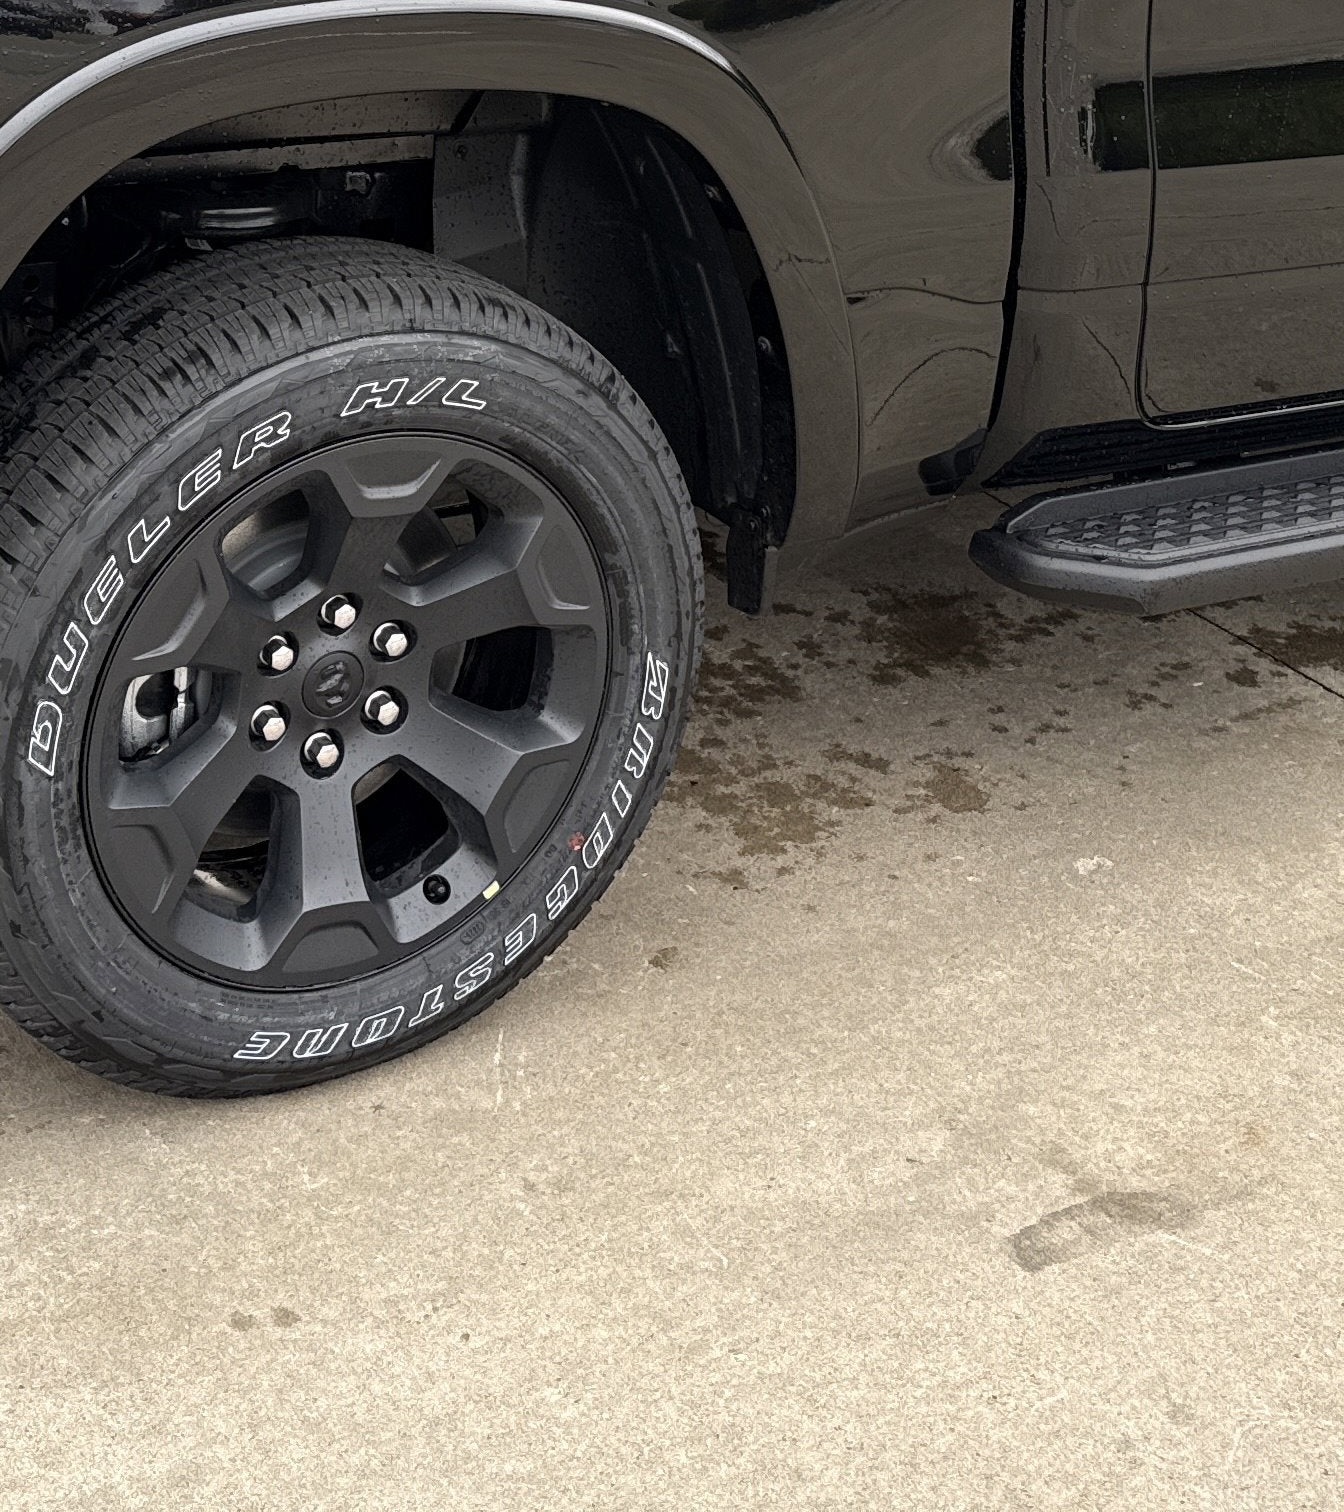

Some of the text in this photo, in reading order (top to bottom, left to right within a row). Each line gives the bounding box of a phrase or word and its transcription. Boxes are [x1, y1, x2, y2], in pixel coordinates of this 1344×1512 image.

[28, 377, 487, 776] DUELER H/L
[234, 651, 670, 1061] BRIDGESTONE
